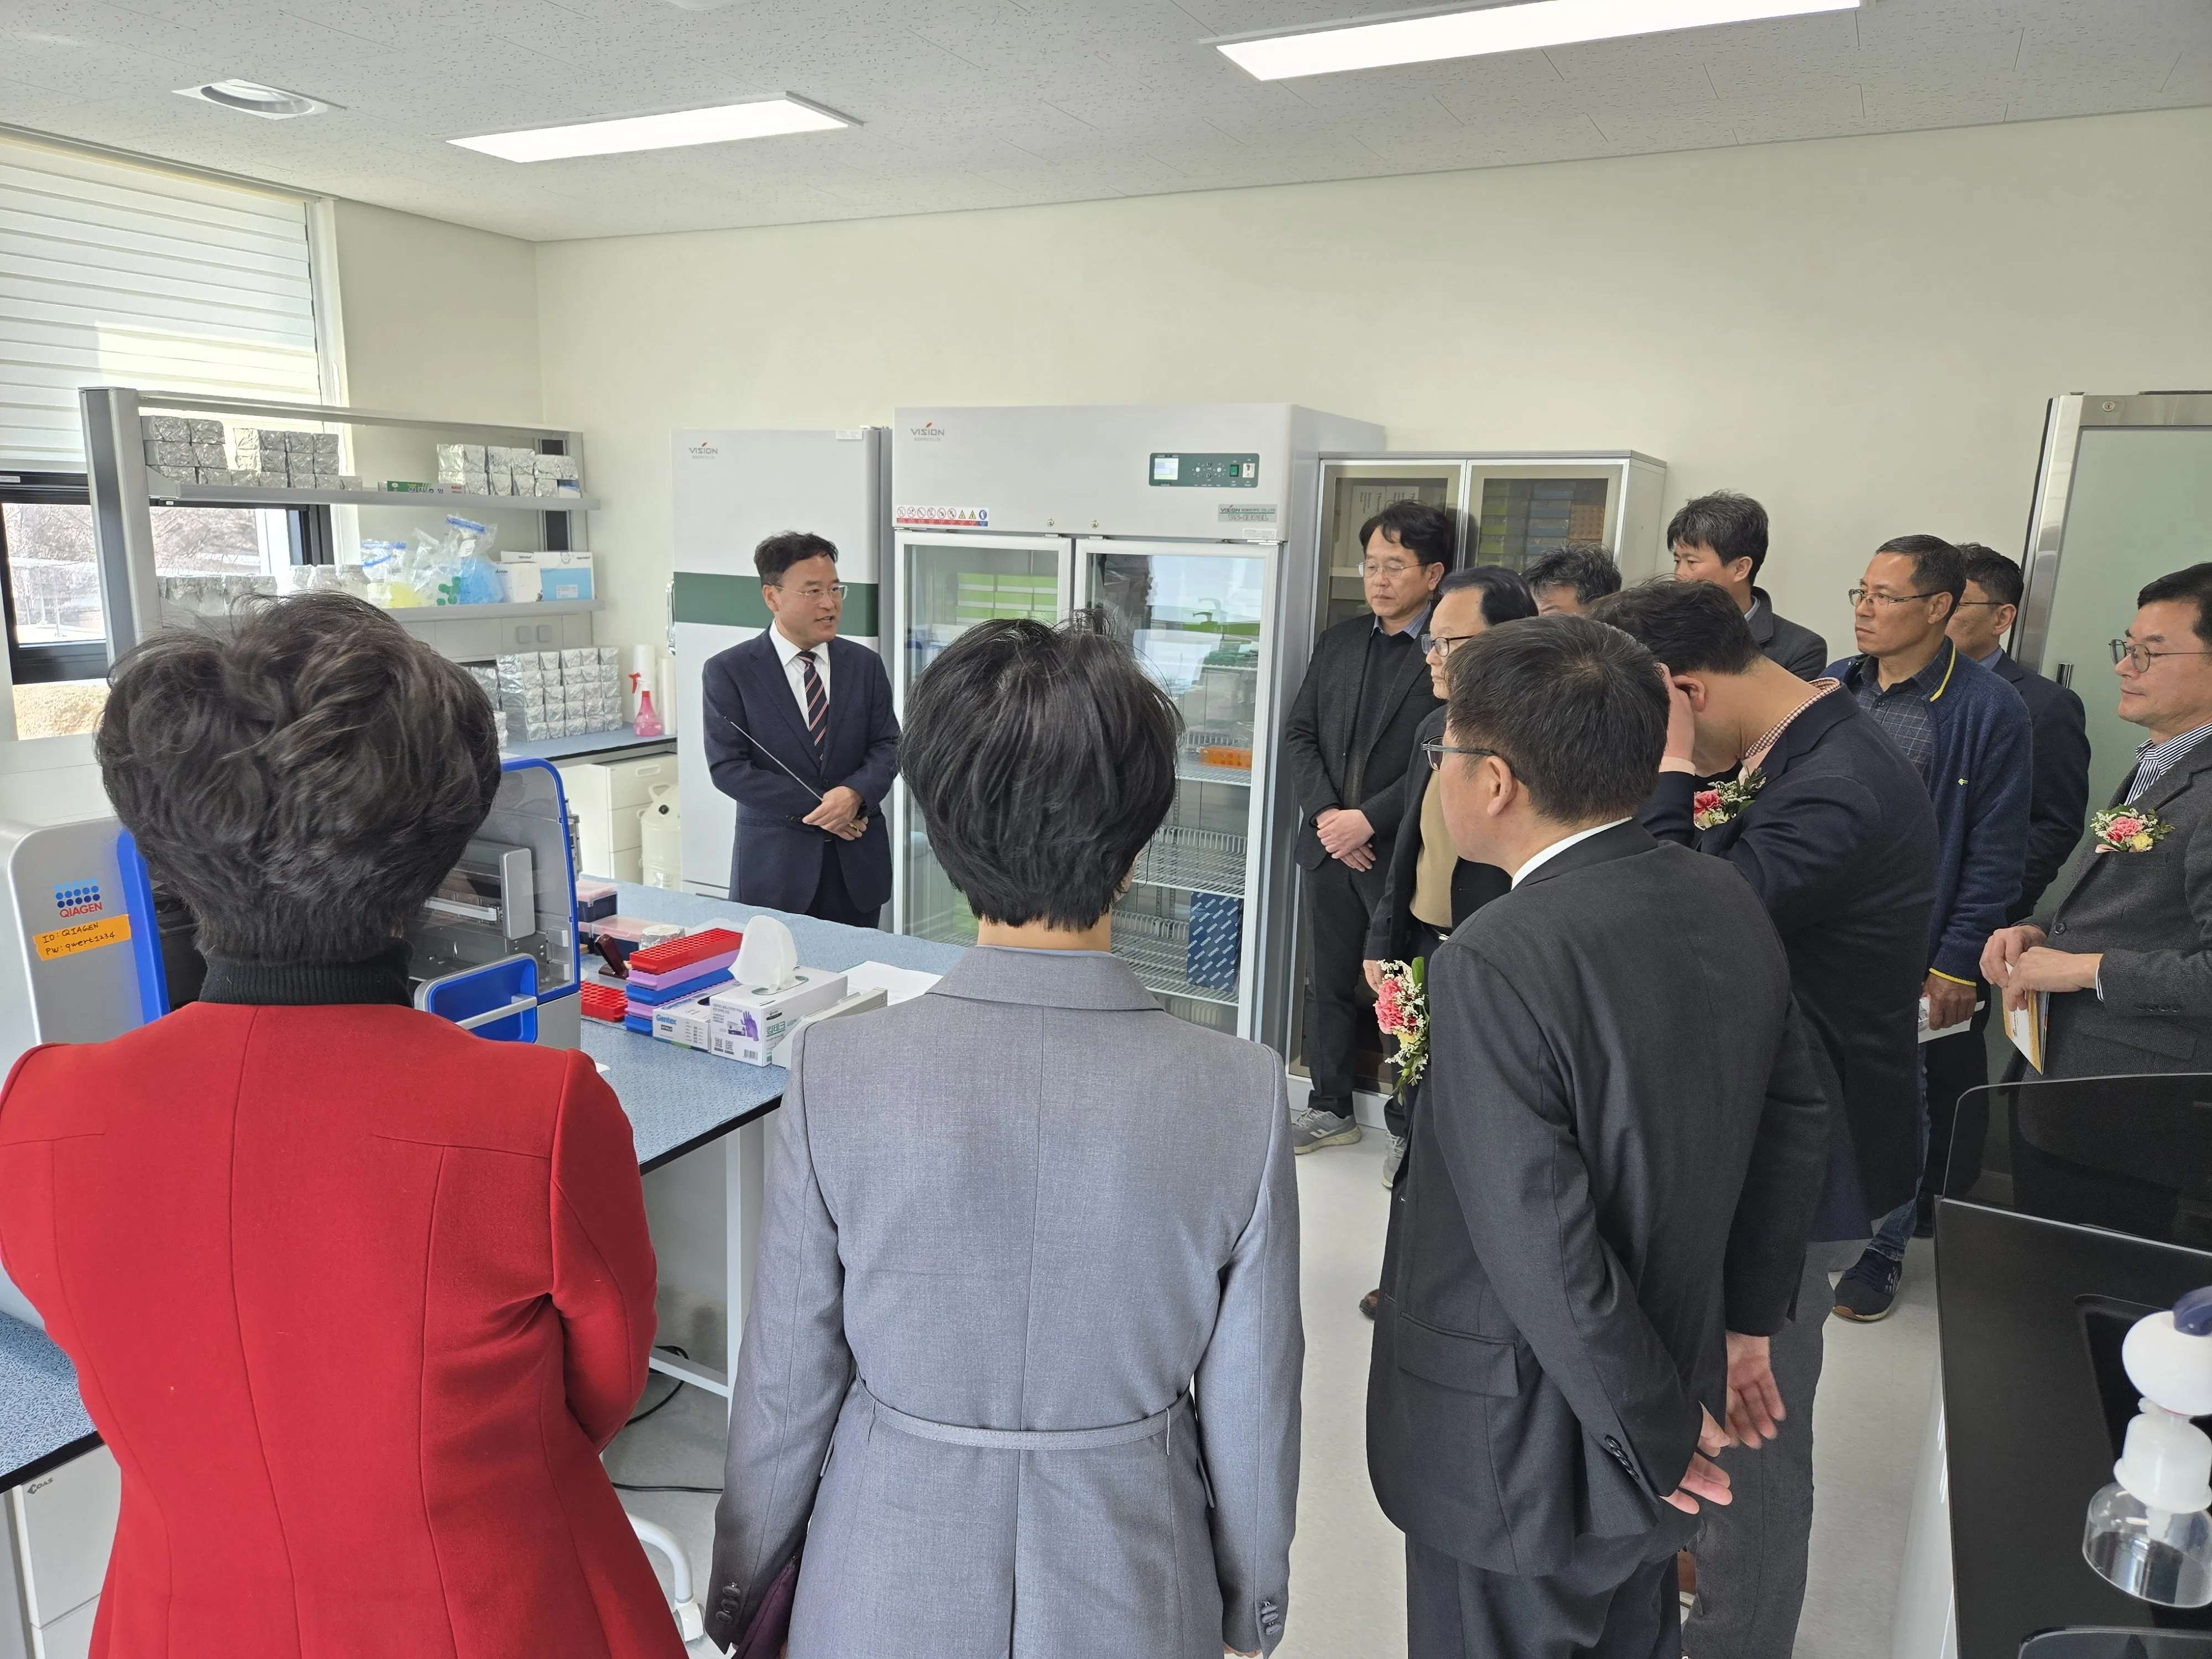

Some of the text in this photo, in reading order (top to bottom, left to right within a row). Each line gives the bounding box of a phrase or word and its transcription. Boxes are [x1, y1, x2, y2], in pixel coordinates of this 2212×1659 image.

[60, 902, 103, 918] QIAGEN
[656, 1014, 677, 1025] Gentex
[766, 1020, 785, 1035] 킴테크
